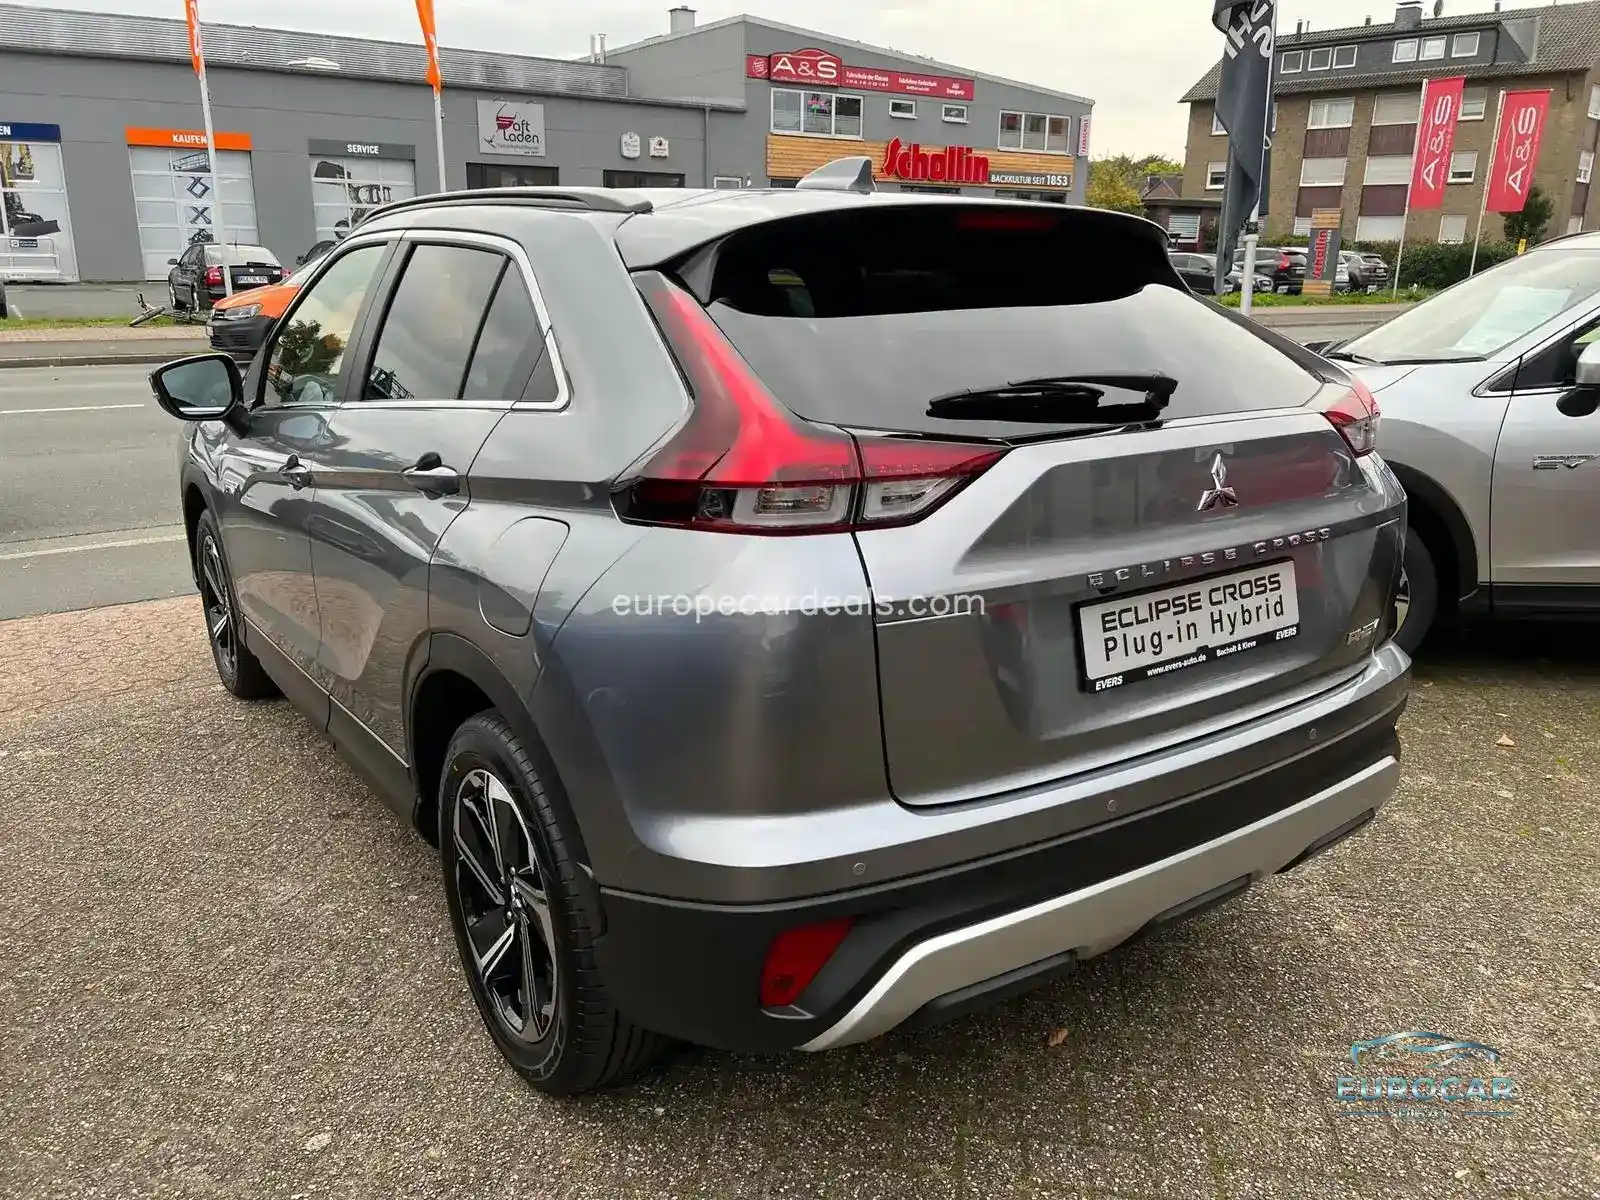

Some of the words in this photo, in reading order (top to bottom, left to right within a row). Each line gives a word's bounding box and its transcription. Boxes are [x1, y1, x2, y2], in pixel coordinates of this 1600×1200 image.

[773, 56, 837, 79] A&S
[172, 133, 208, 145] KAUFEN
[347, 143, 380, 154] SERVICE
[1422, 94, 1452, 190] A&S
[882, 136, 990, 184] Schollin
[1507, 106, 1537, 196] A&S
[991, 174, 1032, 185] BACKKULTUR
[1032, 176, 1045, 185] SEIT
[1046, 174, 1068, 186] 1853
[1087, 548, 1238, 587] ECLIPSE
[1253, 527, 1332, 555] CROSS
[1101, 590, 1203, 633] ECLIPSE
[1208, 573, 1282, 607] CROSS
[1104, 619, 1198, 662] Plug-in
[1210, 595, 1285, 636] Hybrid
[1275, 626, 1297, 641] EVERS
[1216, 643, 1238, 657] Bocholt
[1241, 640, 1257, 650] Kleve
[1146, 653, 1207, 677] www.evers-auto.de
[1095, 675, 1123, 691] EVERS
